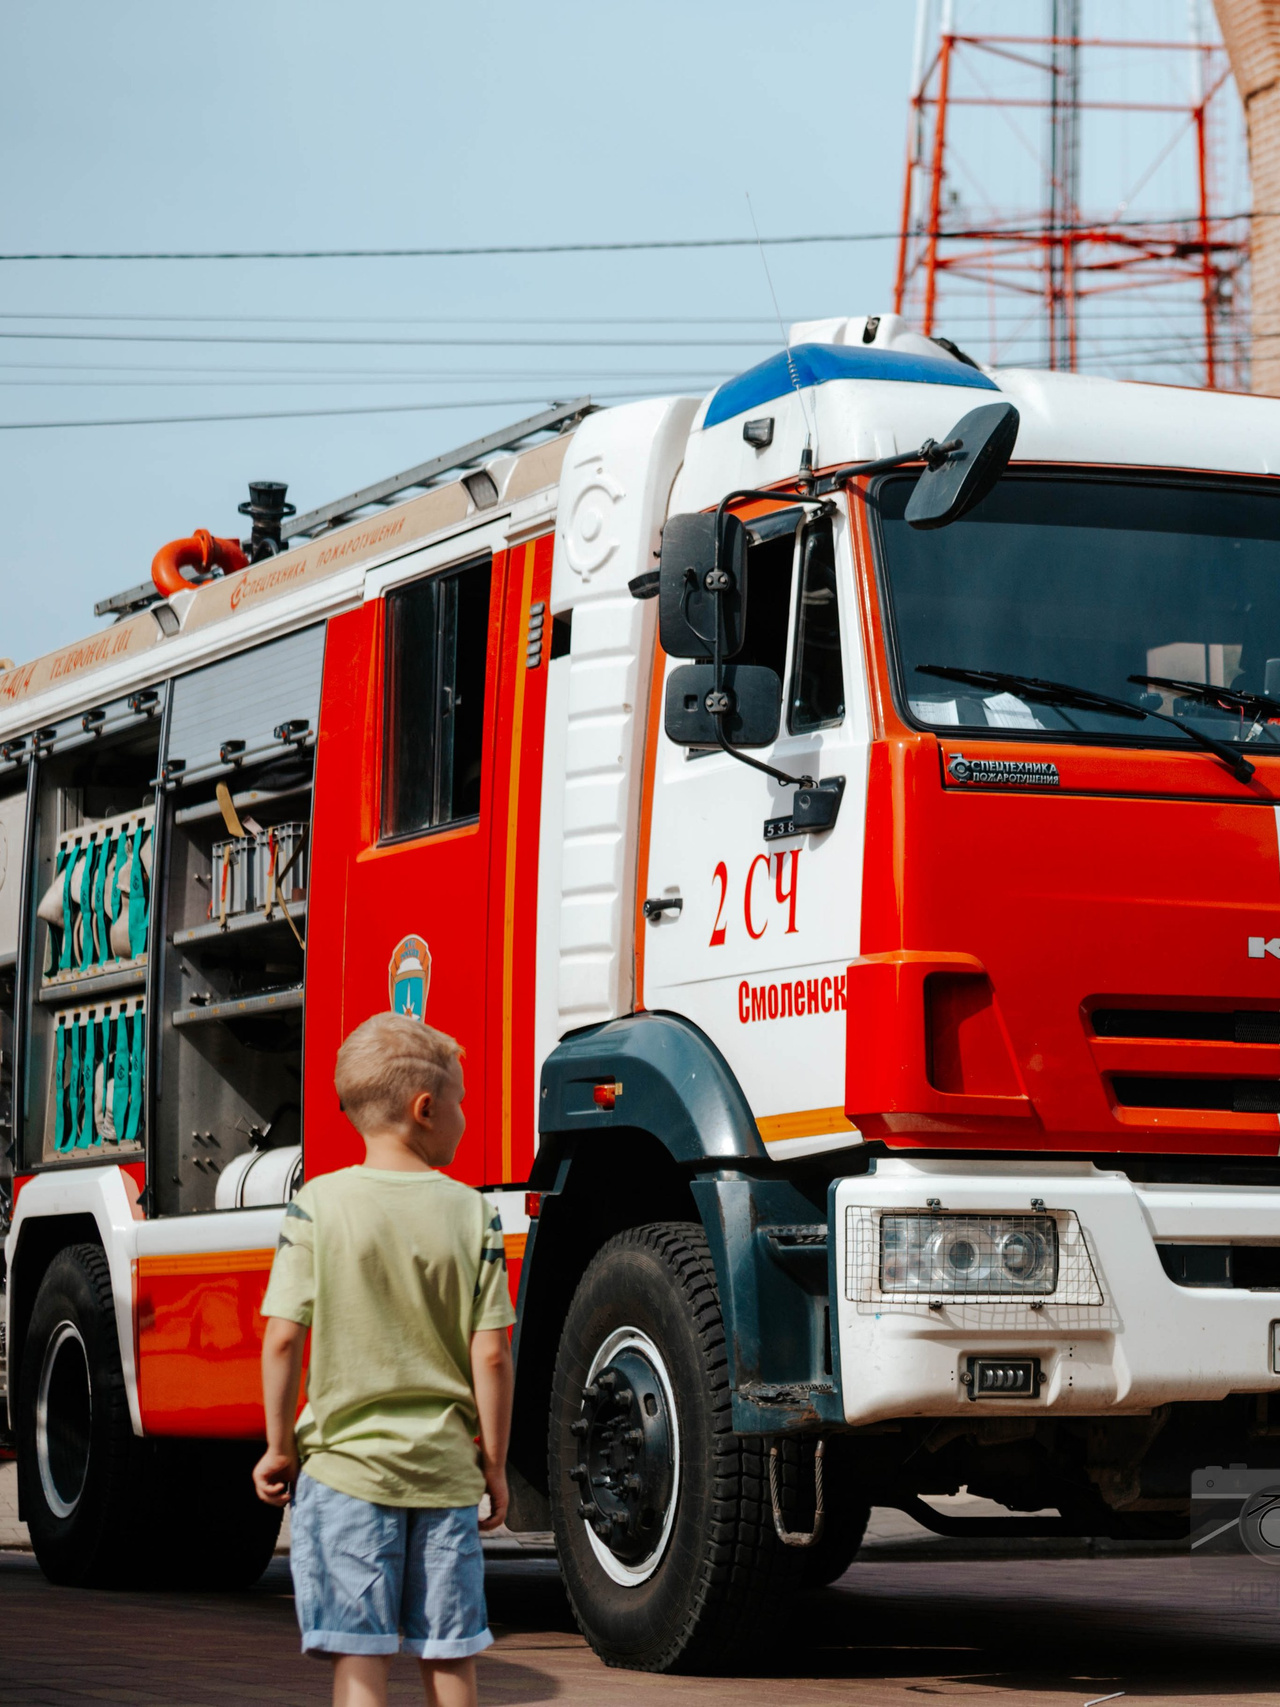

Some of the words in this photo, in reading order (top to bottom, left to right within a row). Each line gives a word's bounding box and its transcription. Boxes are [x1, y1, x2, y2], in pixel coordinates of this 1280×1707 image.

[315, 517, 406, 569] ПОЖАРОТУШЕНИЯ
[971, 760, 1058, 774] СПЕЦТЕХНИКА
[973, 772, 1059, 784] ПОЖАРОТУШЕНИЯ
[767, 821, 796, 837] 538
[709, 861, 728, 947] 2
[744, 848, 803, 940] СЧ
[738, 974, 848, 1025] Смоленск
